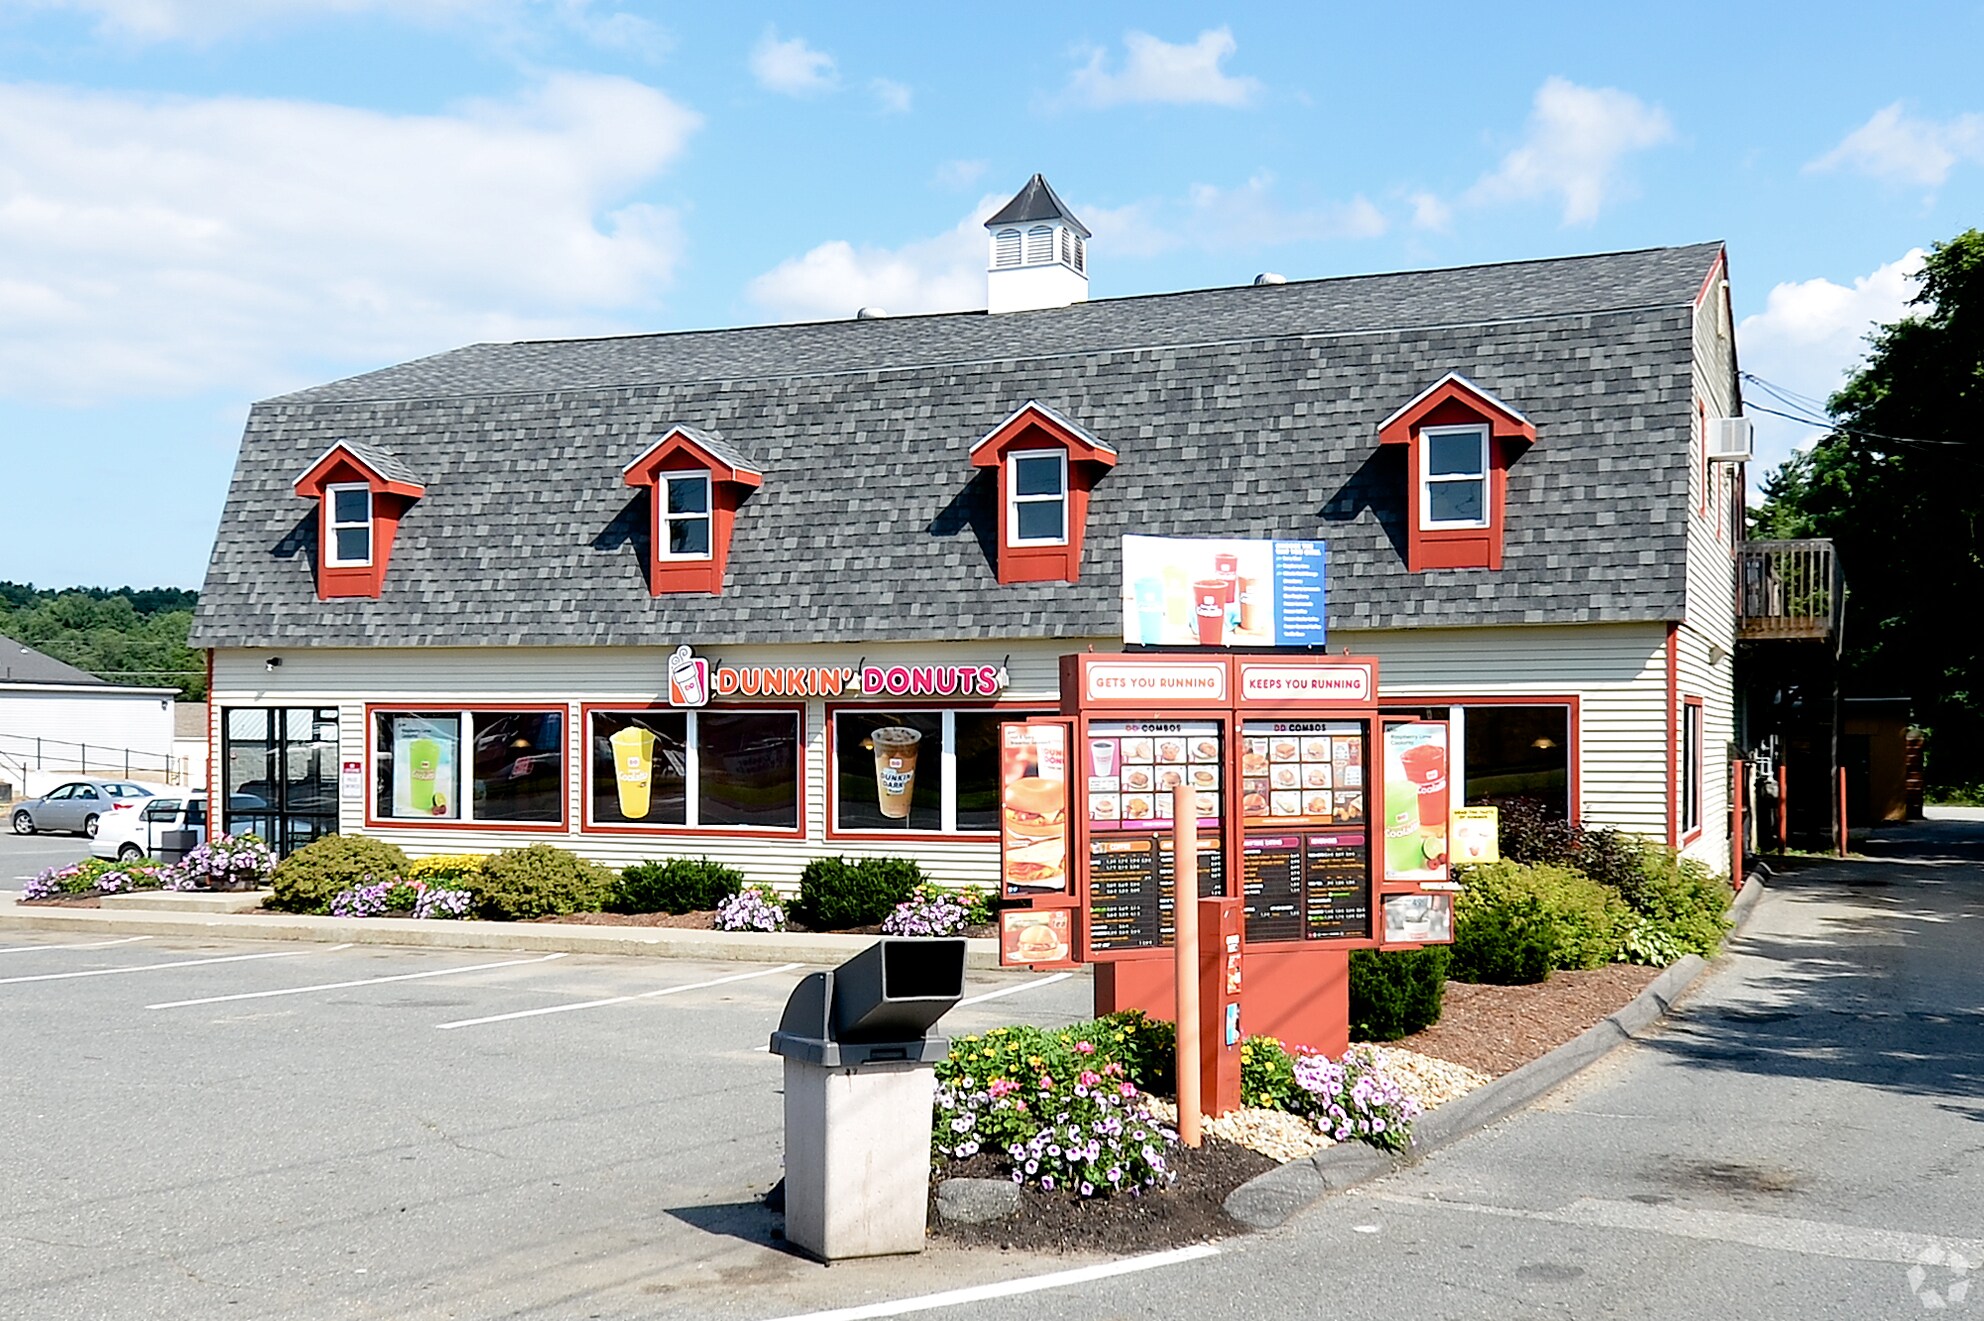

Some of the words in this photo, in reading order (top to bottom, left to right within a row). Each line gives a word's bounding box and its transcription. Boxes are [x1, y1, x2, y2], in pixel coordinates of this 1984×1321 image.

[717, 666, 851, 696] DUNKIN'
[862, 665, 998, 695] DONUTS
[1096, 677, 1126, 688] GETS
[1130, 678, 1155, 688] YOU
[1160, 678, 1216, 689] RUNNING
[1249, 679, 1282, 689] KEEPS
[1285, 679, 1308, 690] YOU
[1311, 679, 1361, 690] RUNNING
[1141, 724, 1181, 732] COMBOS
[1273, 724, 1286, 732] DD
[1288, 723, 1327, 732] COMBOS
